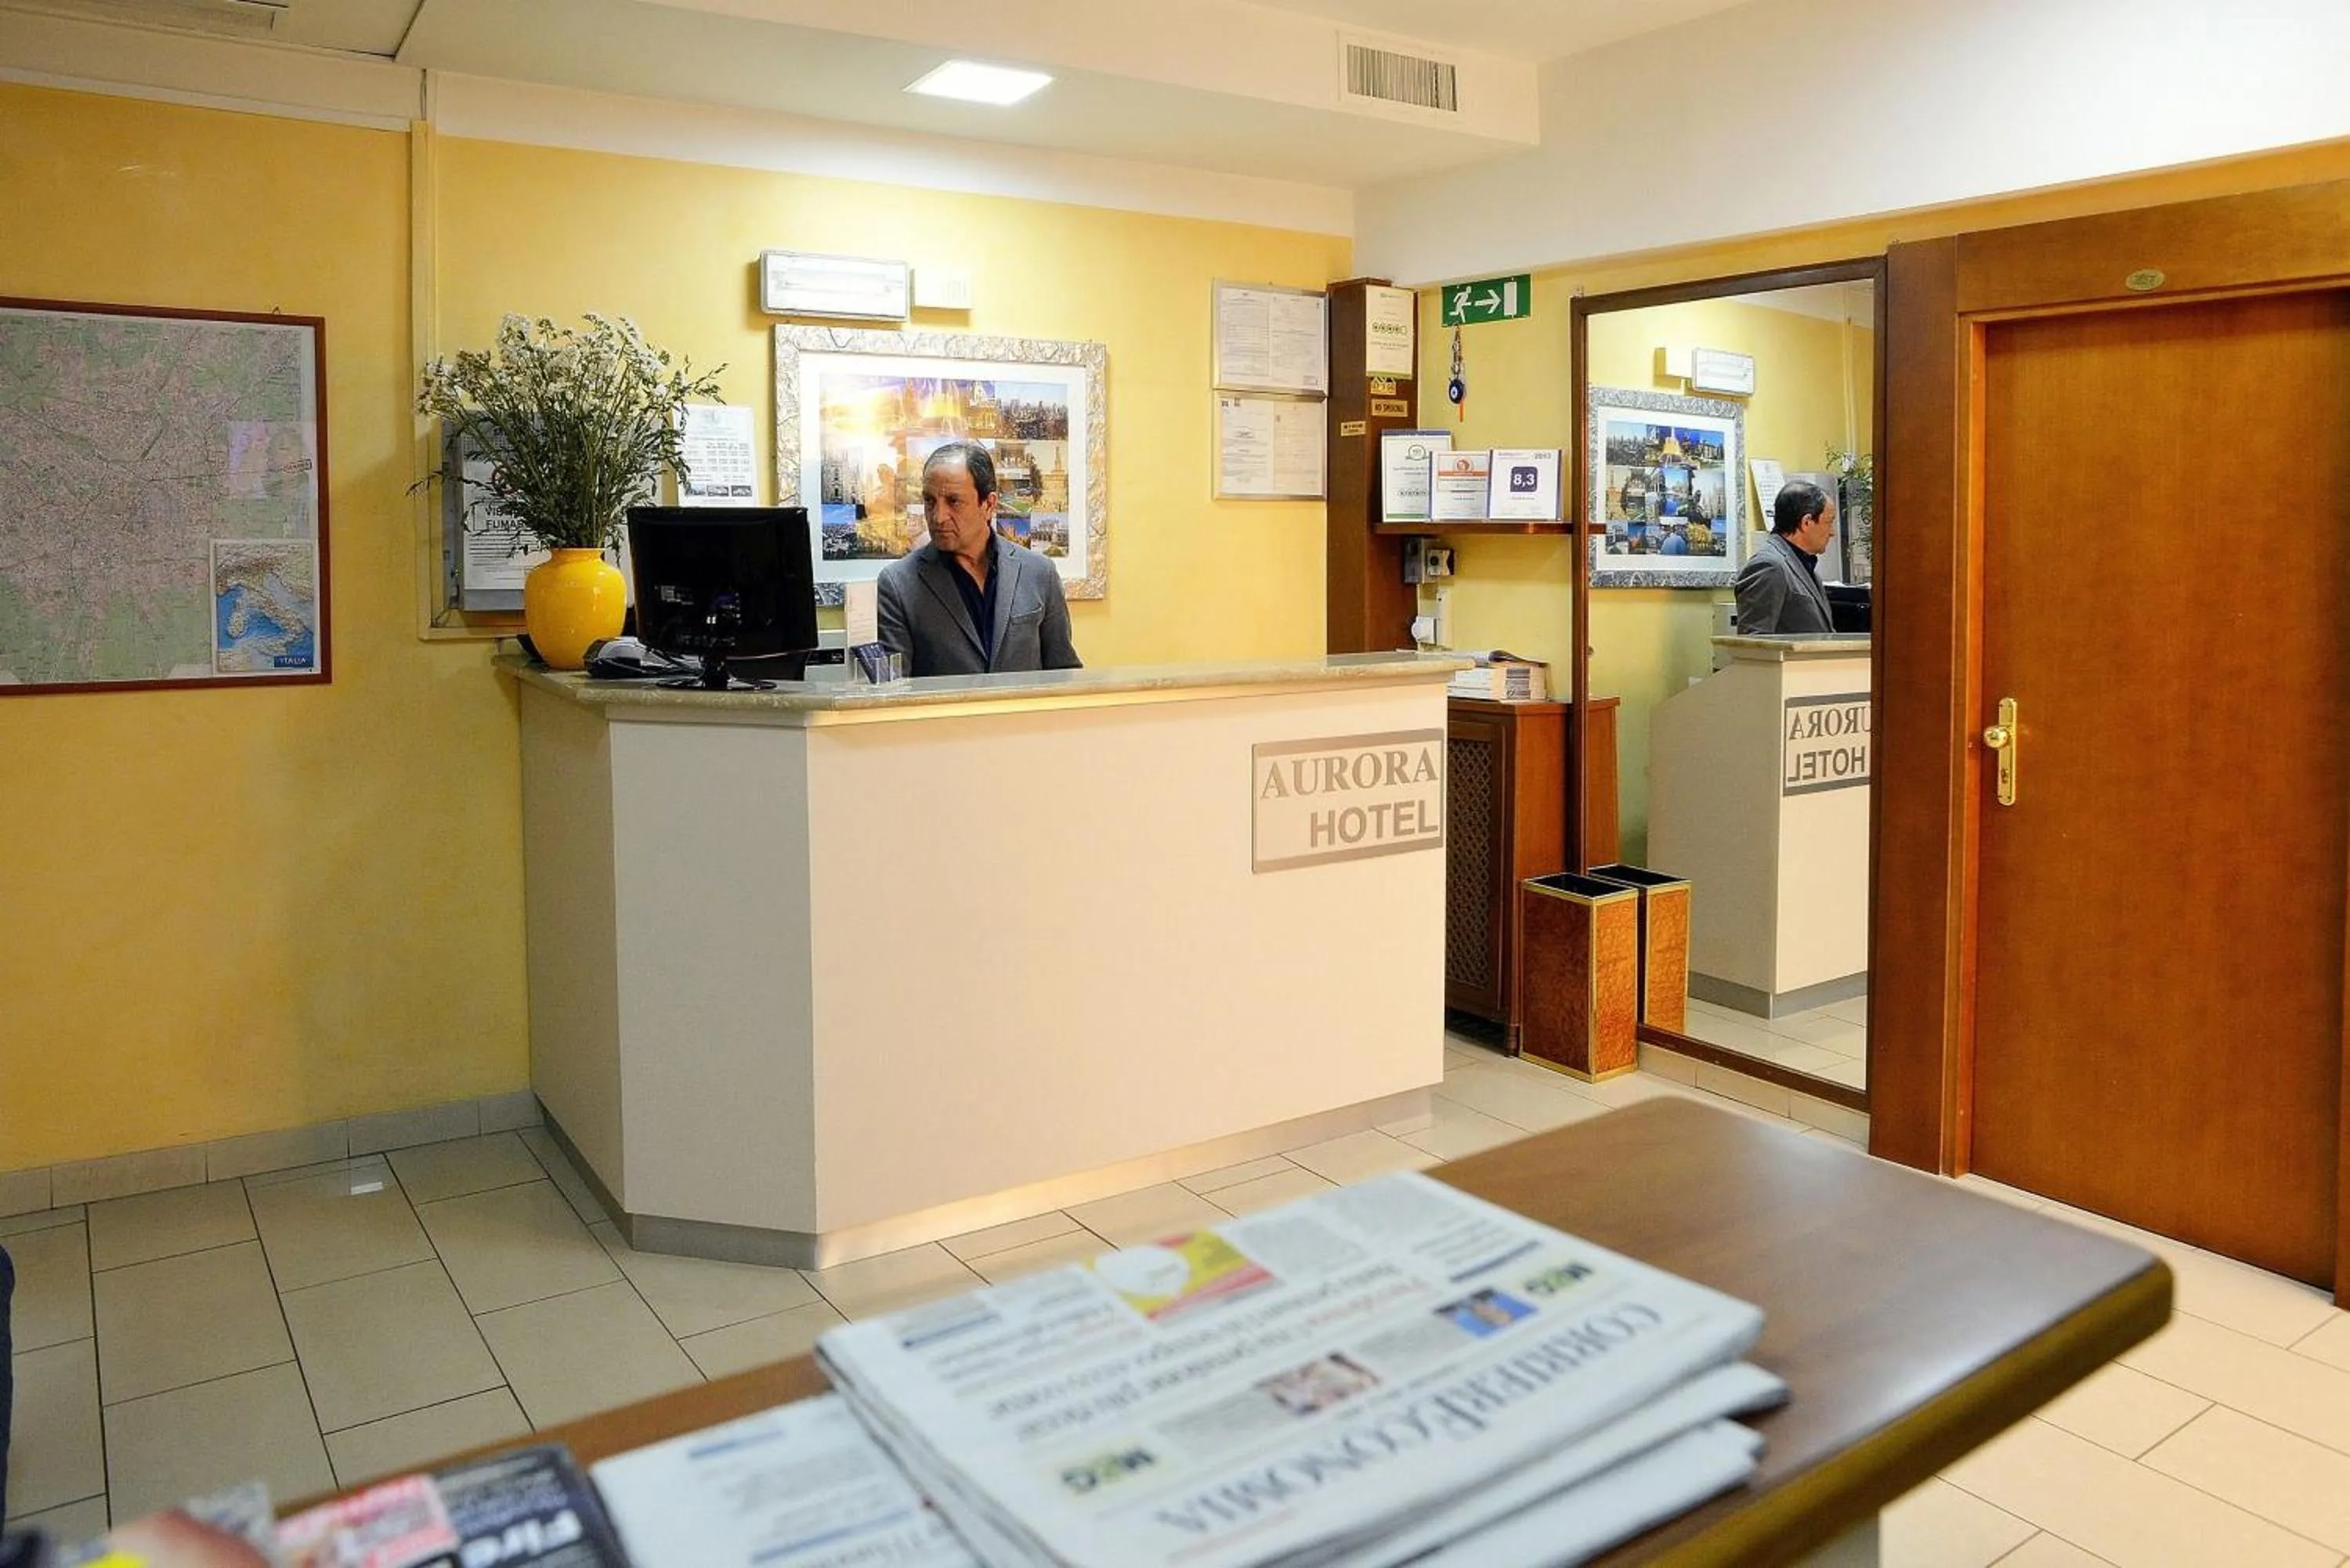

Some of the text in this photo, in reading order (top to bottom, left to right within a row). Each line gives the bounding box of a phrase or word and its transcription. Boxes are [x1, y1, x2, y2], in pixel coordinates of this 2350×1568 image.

[1513, 473, 1535, 487] 8,3
[1260, 746, 1439, 799] AURORA
[1311, 800, 1439, 847] HOTEL
